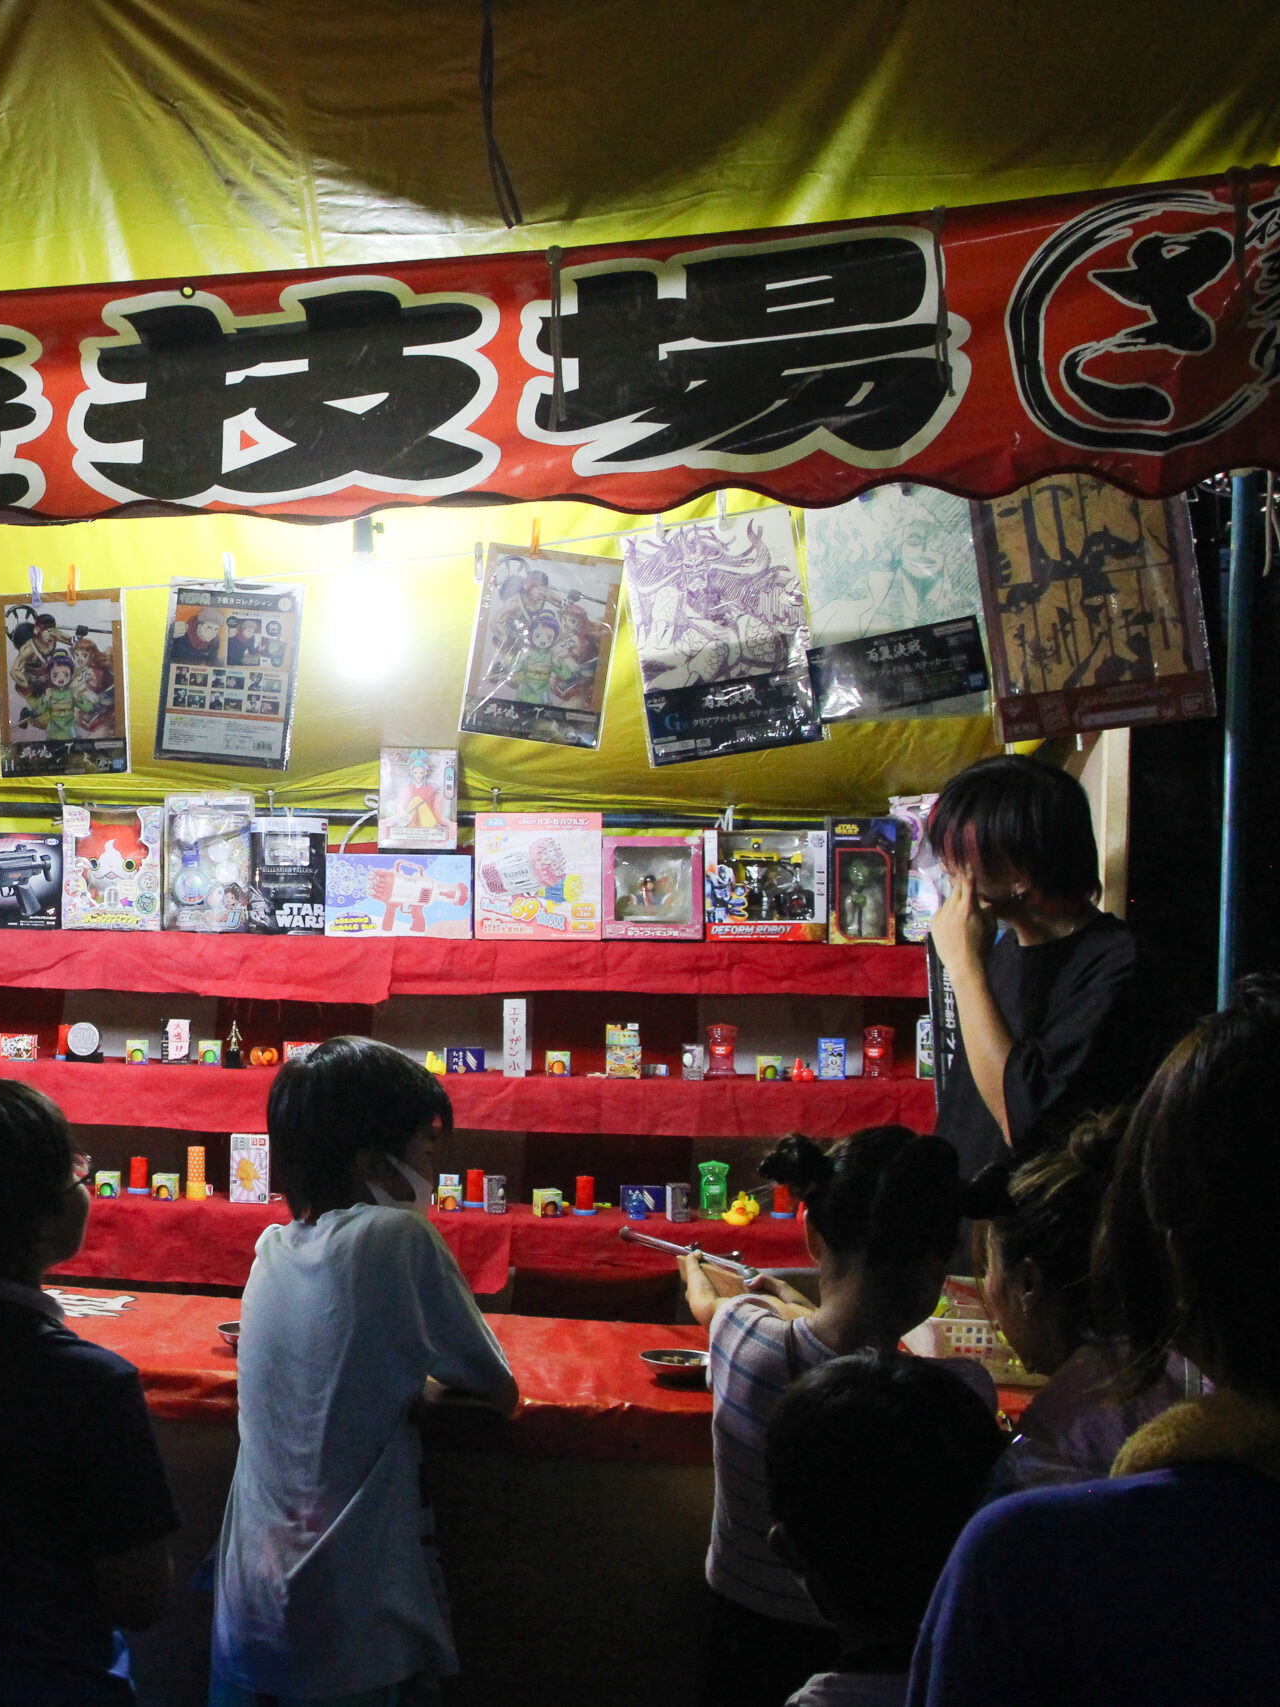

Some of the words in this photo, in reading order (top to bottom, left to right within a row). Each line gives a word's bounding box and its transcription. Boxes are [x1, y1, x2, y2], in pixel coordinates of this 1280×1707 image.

[276, 903, 325, 915] STAR
[275, 914, 325, 929] WARS
[710, 925, 756, 935] DEFORM
